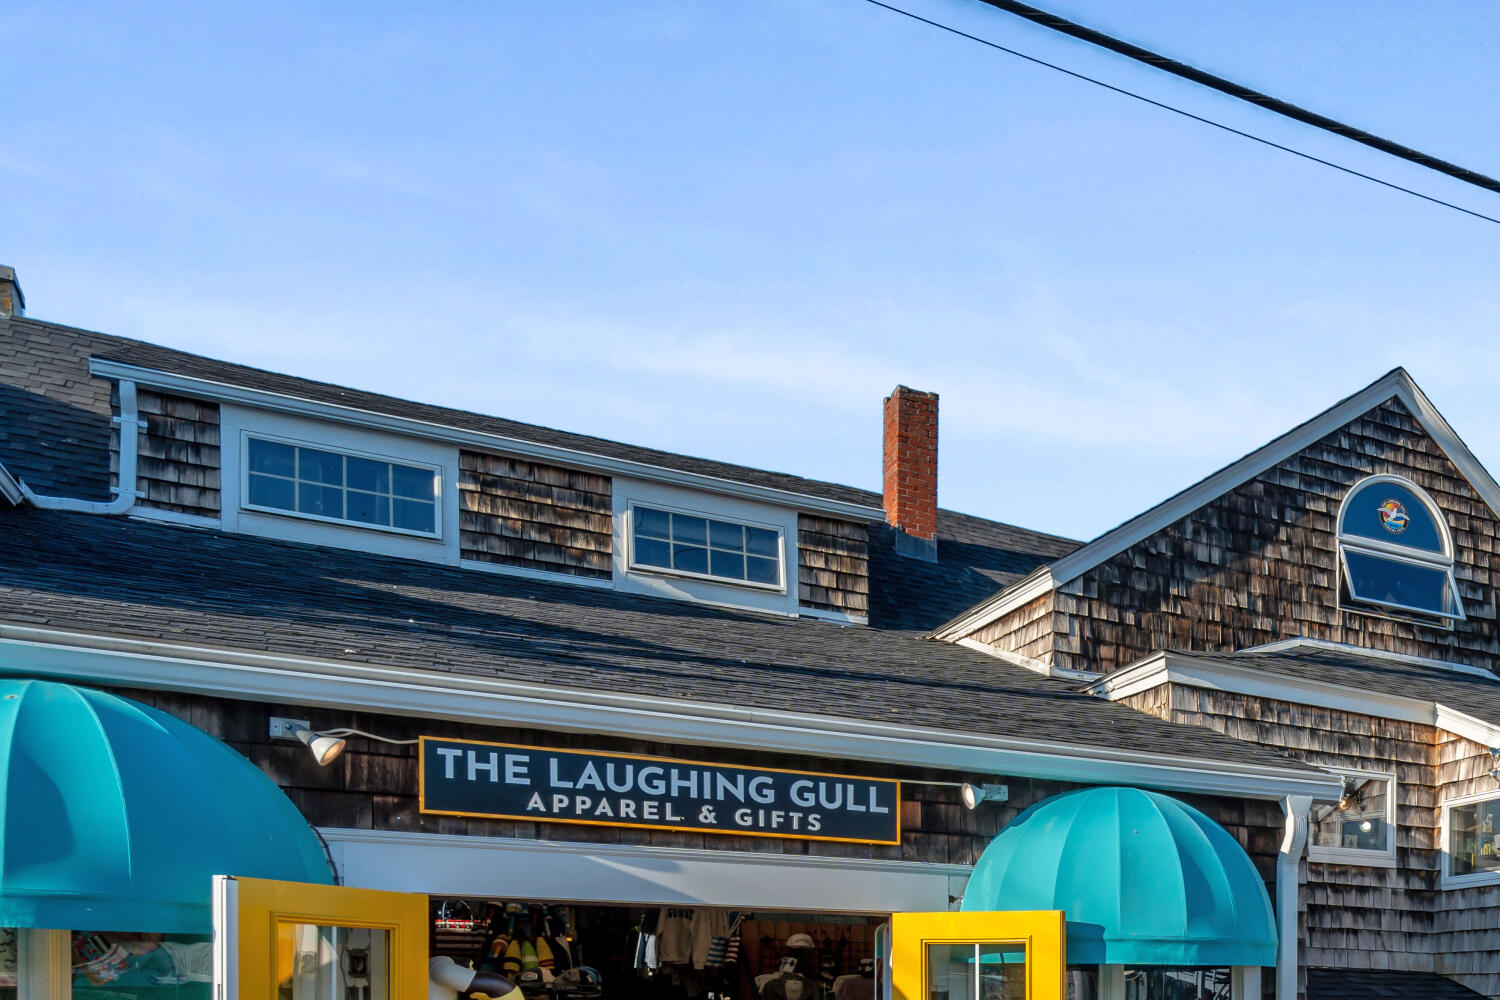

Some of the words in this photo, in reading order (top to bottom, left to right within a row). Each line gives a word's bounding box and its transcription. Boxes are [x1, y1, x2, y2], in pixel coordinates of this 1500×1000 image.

[436, 747, 531, 785] THE
[549, 757, 775, 804] LAUGHING
[790, 779, 889, 814] GULL
[526, 791, 684, 822] APPAREL
[699, 804, 717, 824] &
[735, 808, 821, 832] GIFTS
